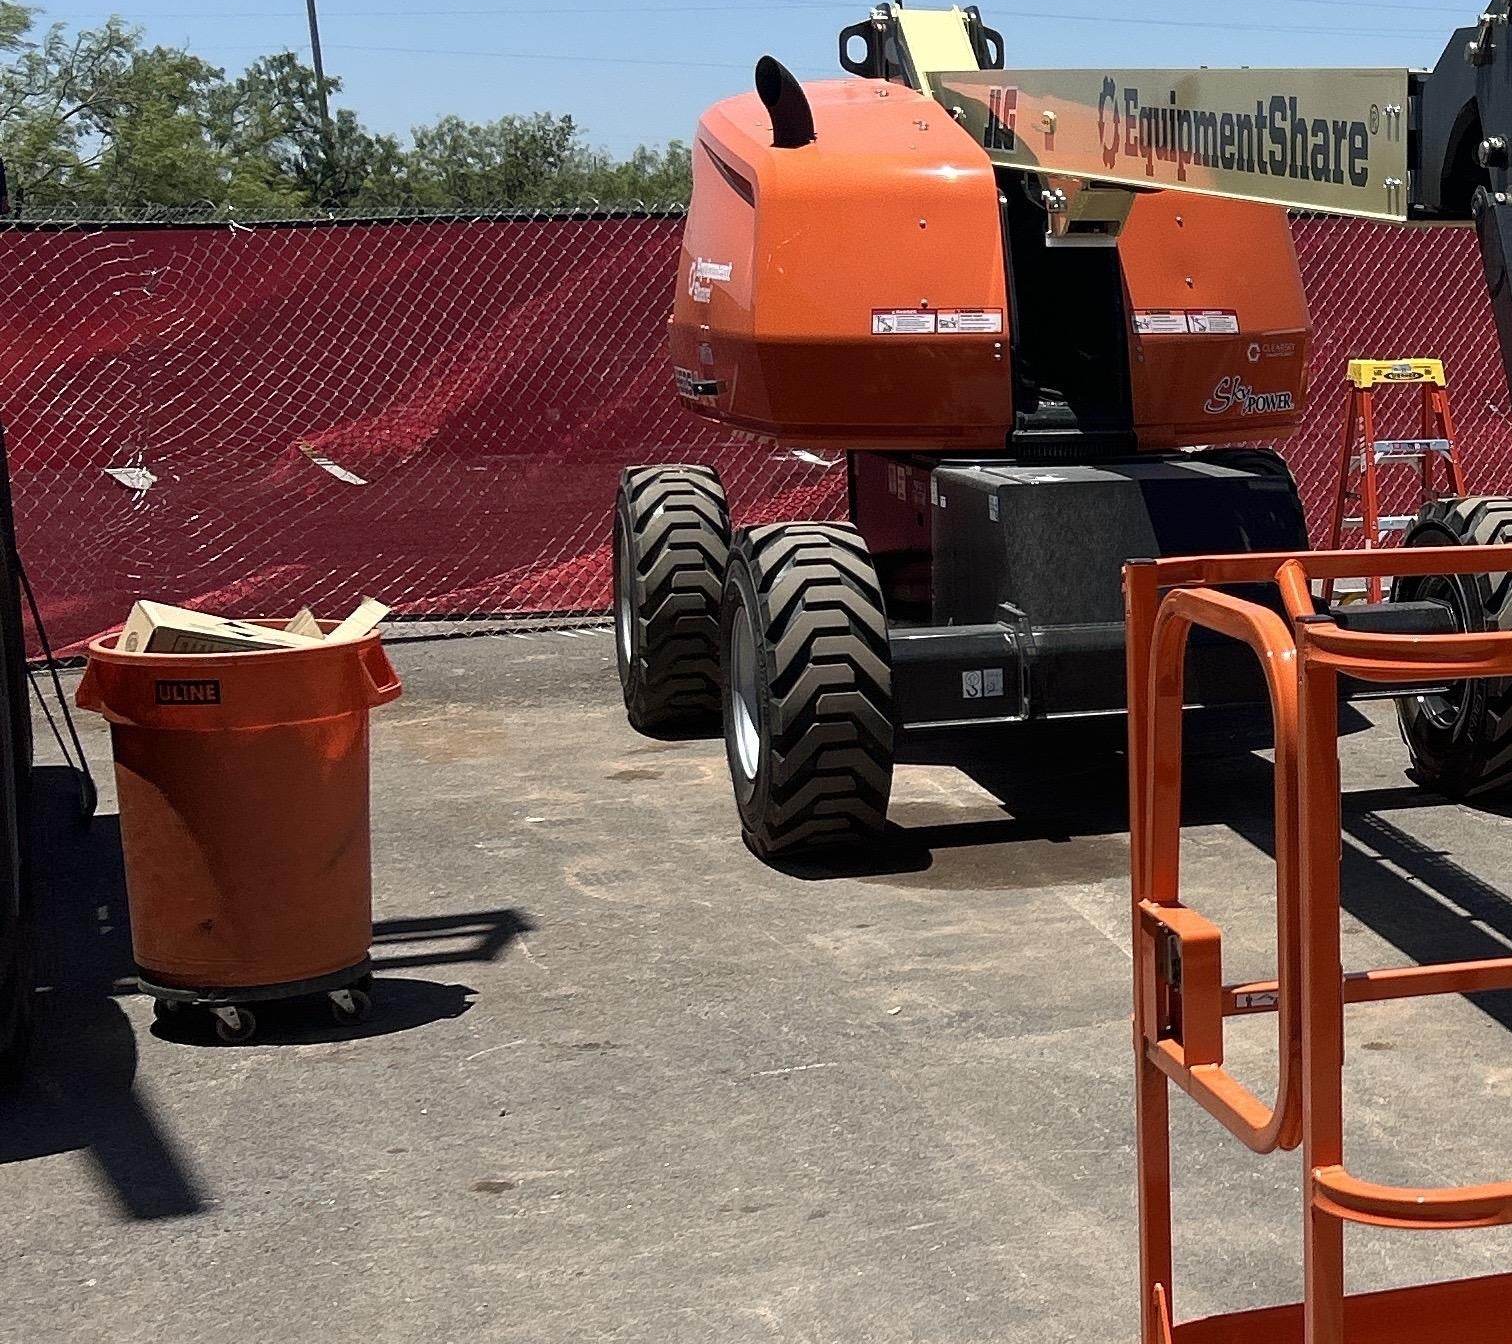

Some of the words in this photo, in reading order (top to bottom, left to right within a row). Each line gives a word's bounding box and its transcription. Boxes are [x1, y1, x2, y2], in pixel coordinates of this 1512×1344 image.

[983, 85, 1018, 154] JLG
[1123, 88, 1370, 188] EquipmentShare
[158, 682, 217, 702] ULINE
